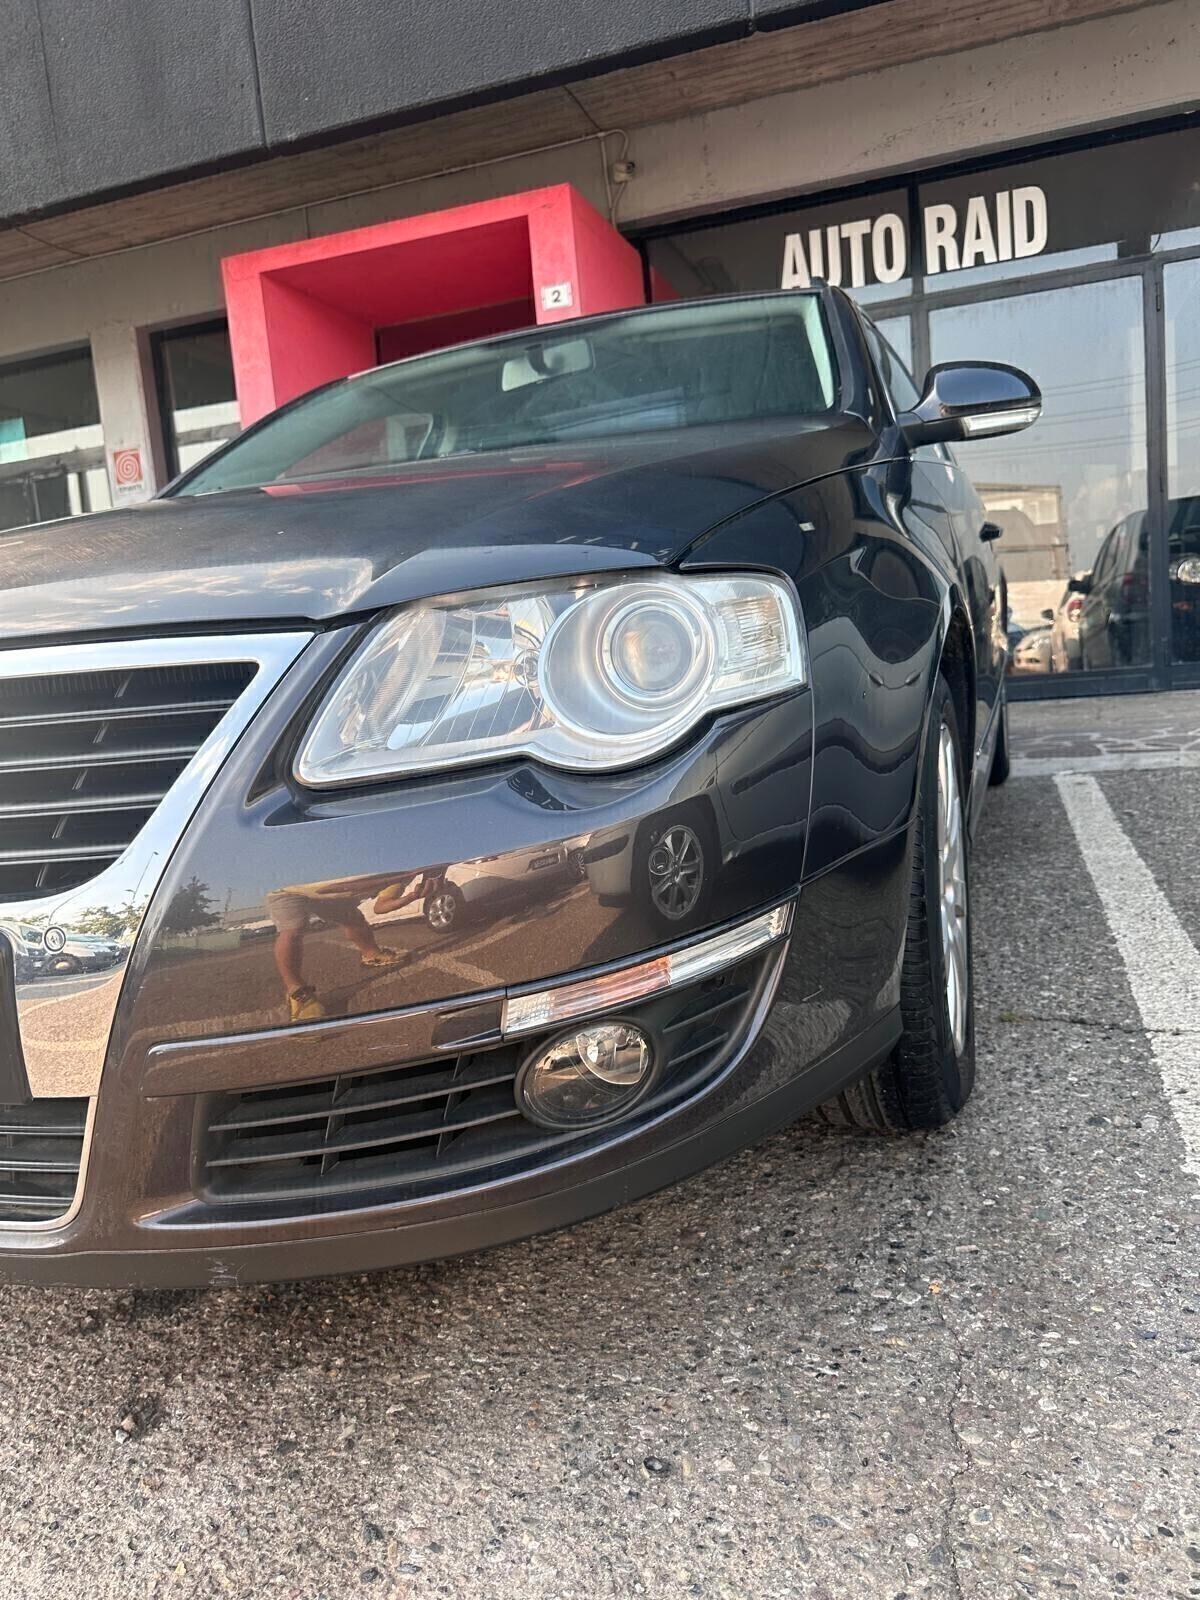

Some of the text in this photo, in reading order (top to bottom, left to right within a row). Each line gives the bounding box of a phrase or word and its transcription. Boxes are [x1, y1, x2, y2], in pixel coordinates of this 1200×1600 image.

[781, 185, 1048, 289] AUTO RAID
[552, 289, 561, 303] 2
